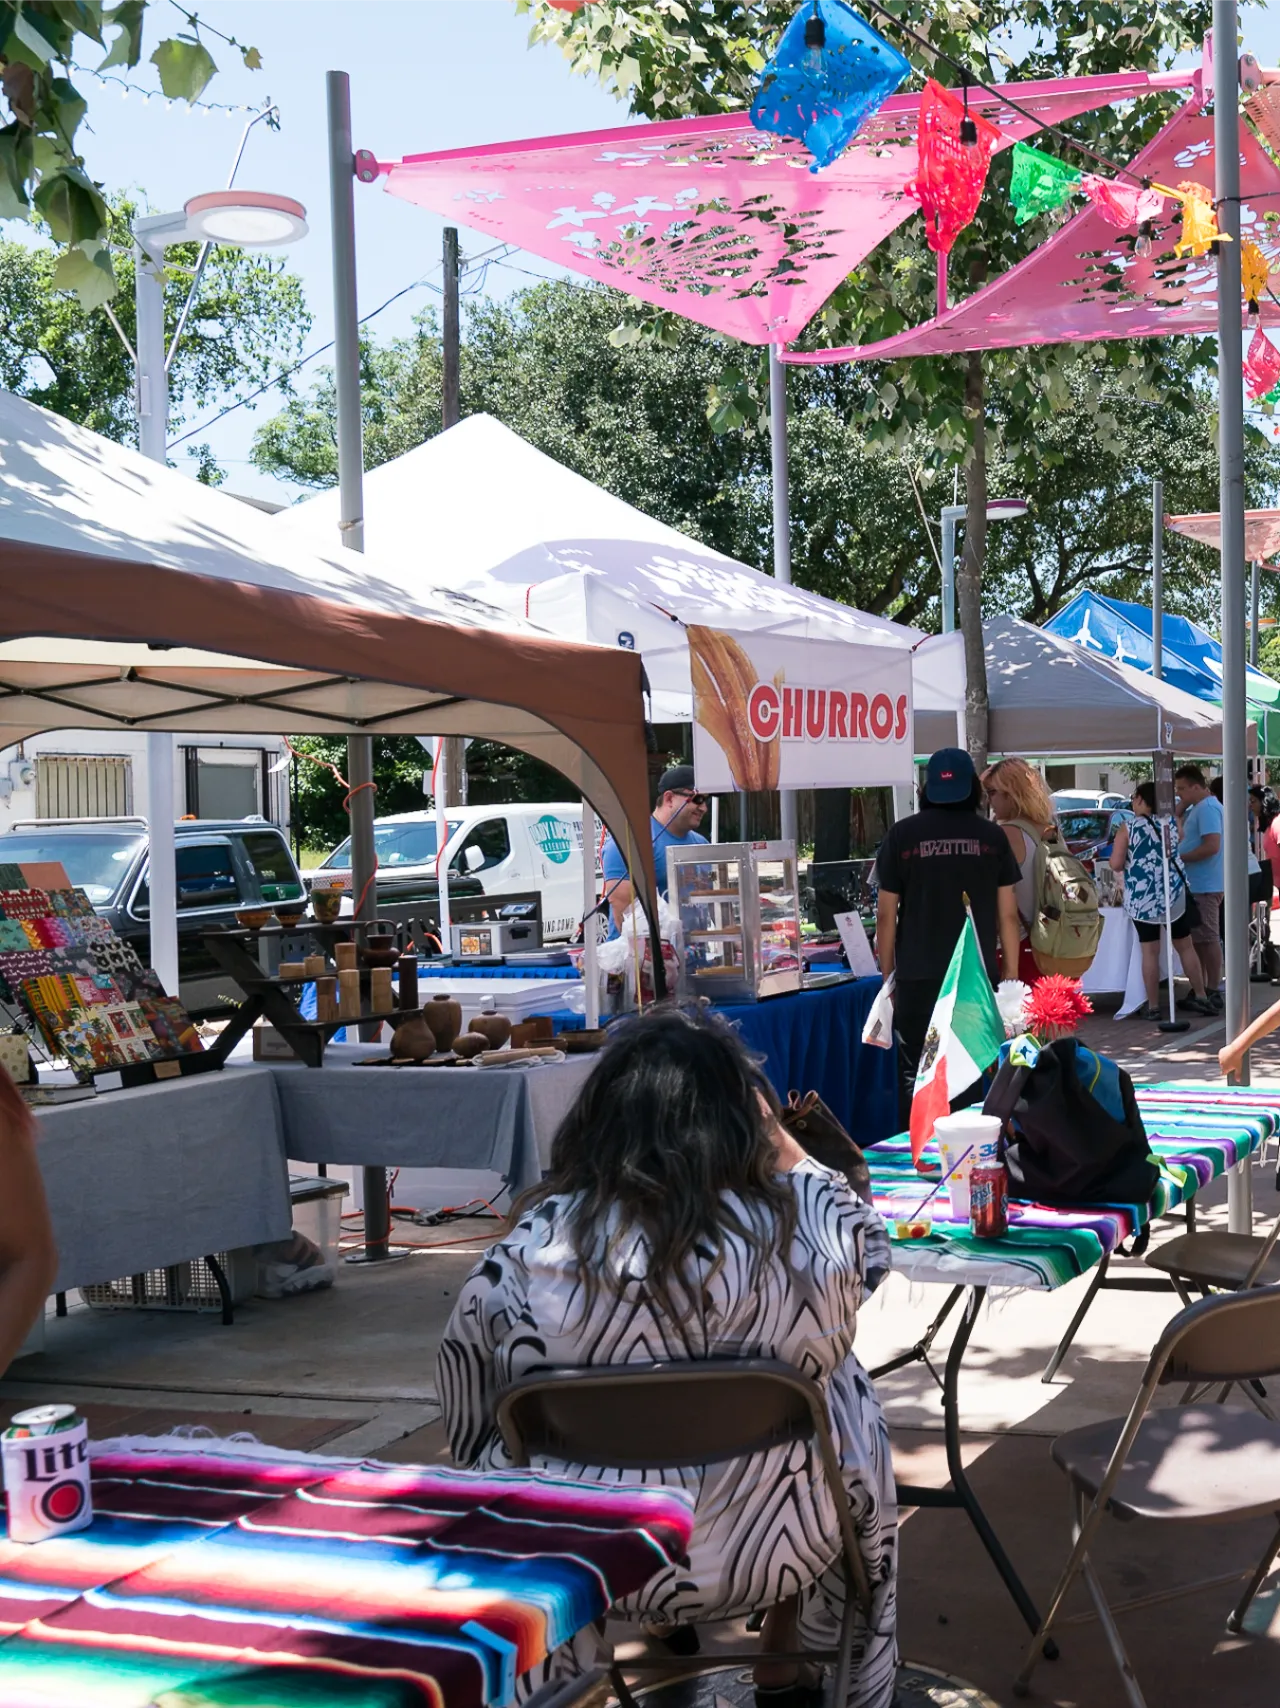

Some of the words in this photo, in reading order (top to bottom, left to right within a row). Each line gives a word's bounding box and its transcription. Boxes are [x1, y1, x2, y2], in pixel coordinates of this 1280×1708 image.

[749, 684, 909, 741] CHURROS
[529, 822, 550, 844] LADY
[550, 821, 572, 841] LUCK
[24, 1438, 88, 1482] Lite
